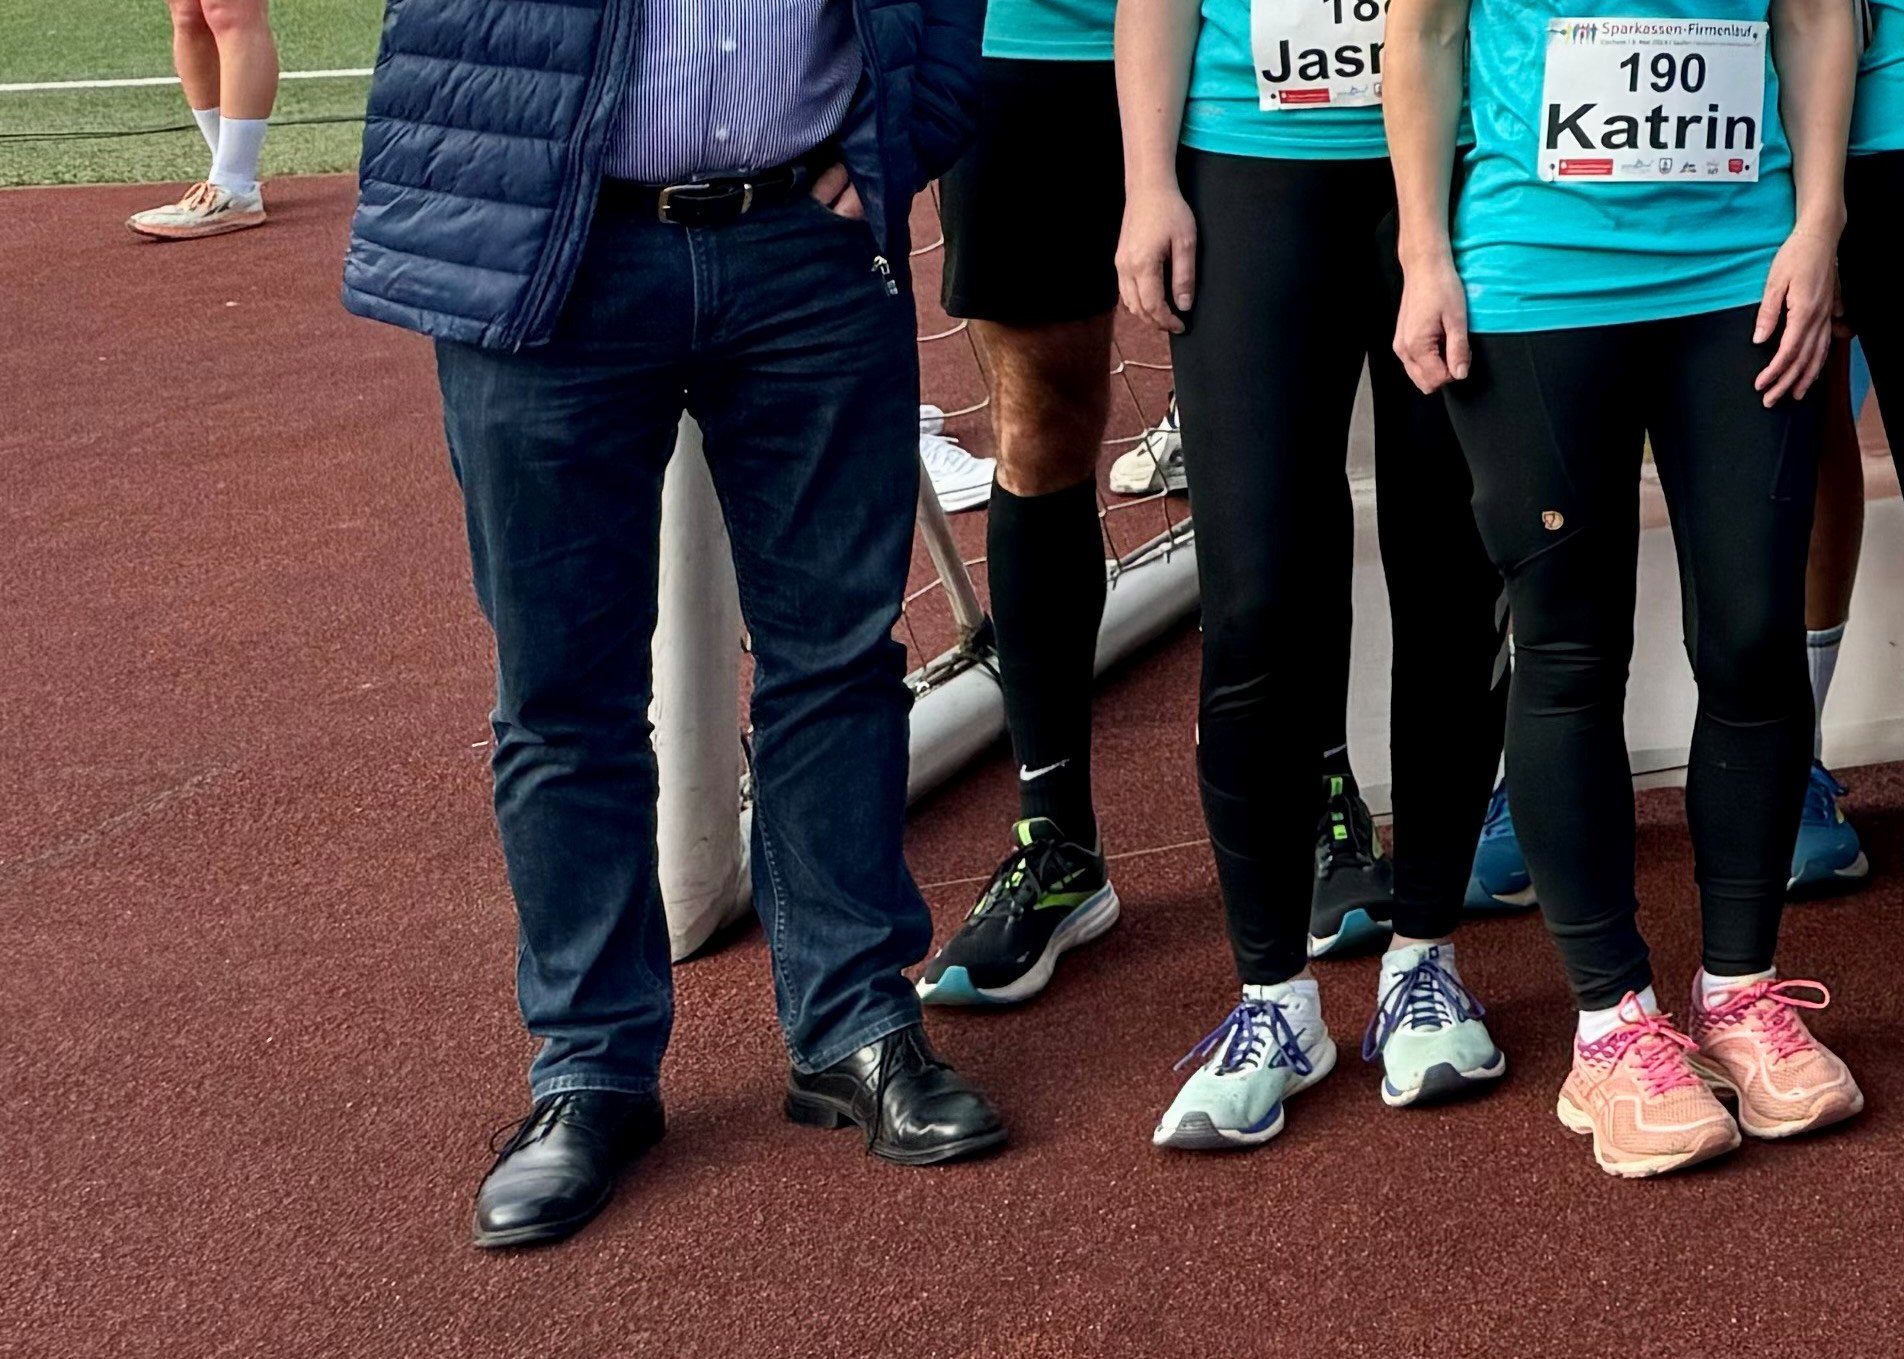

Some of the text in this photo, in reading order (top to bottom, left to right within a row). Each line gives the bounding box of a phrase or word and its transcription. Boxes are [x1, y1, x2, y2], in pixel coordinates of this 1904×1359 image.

[1601, 21, 1752, 39] Sparkassen-Firmenlauf
[1619, 52, 1707, 93] 190
[1545, 103, 1757, 150] Katrin
